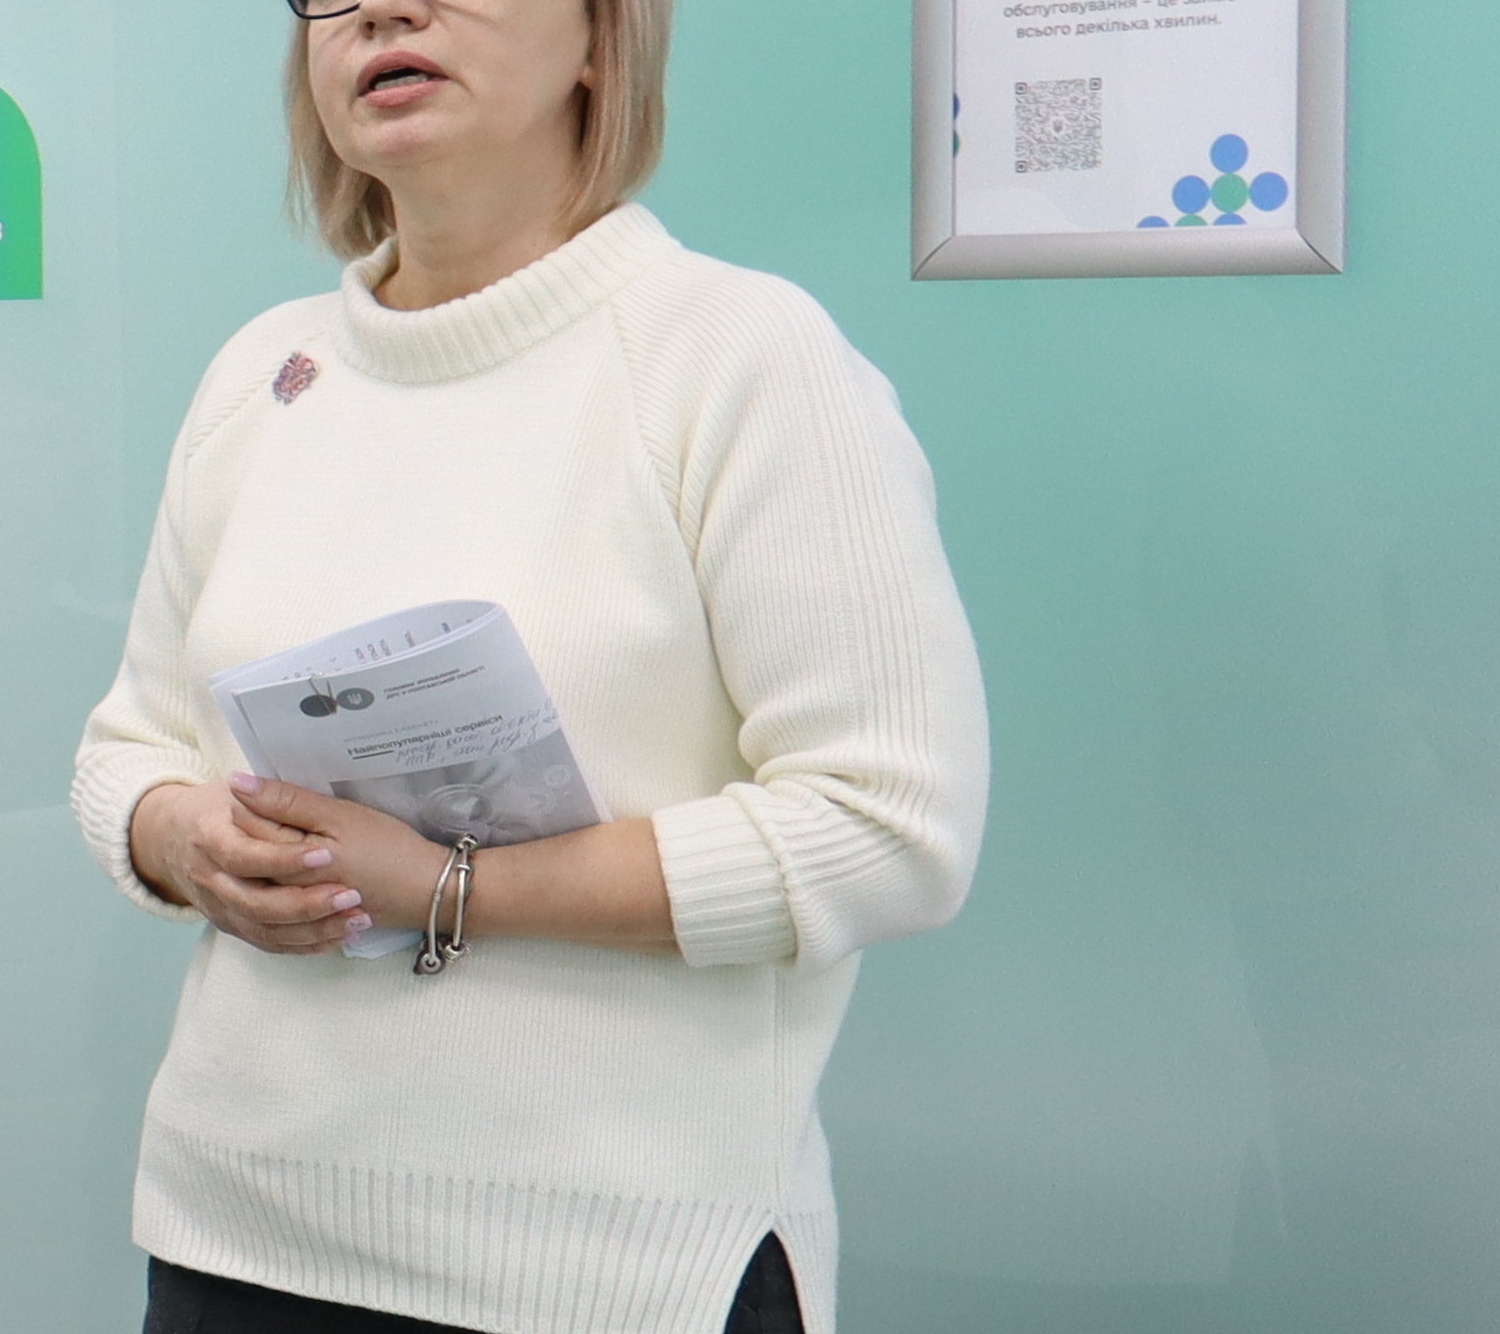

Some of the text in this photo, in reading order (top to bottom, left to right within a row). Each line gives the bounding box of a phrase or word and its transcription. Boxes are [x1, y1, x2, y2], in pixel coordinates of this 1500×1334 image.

[1016, 13, 1222, 40] всього декілька хвилин.
[454, 714, 504, 735] сервіси
